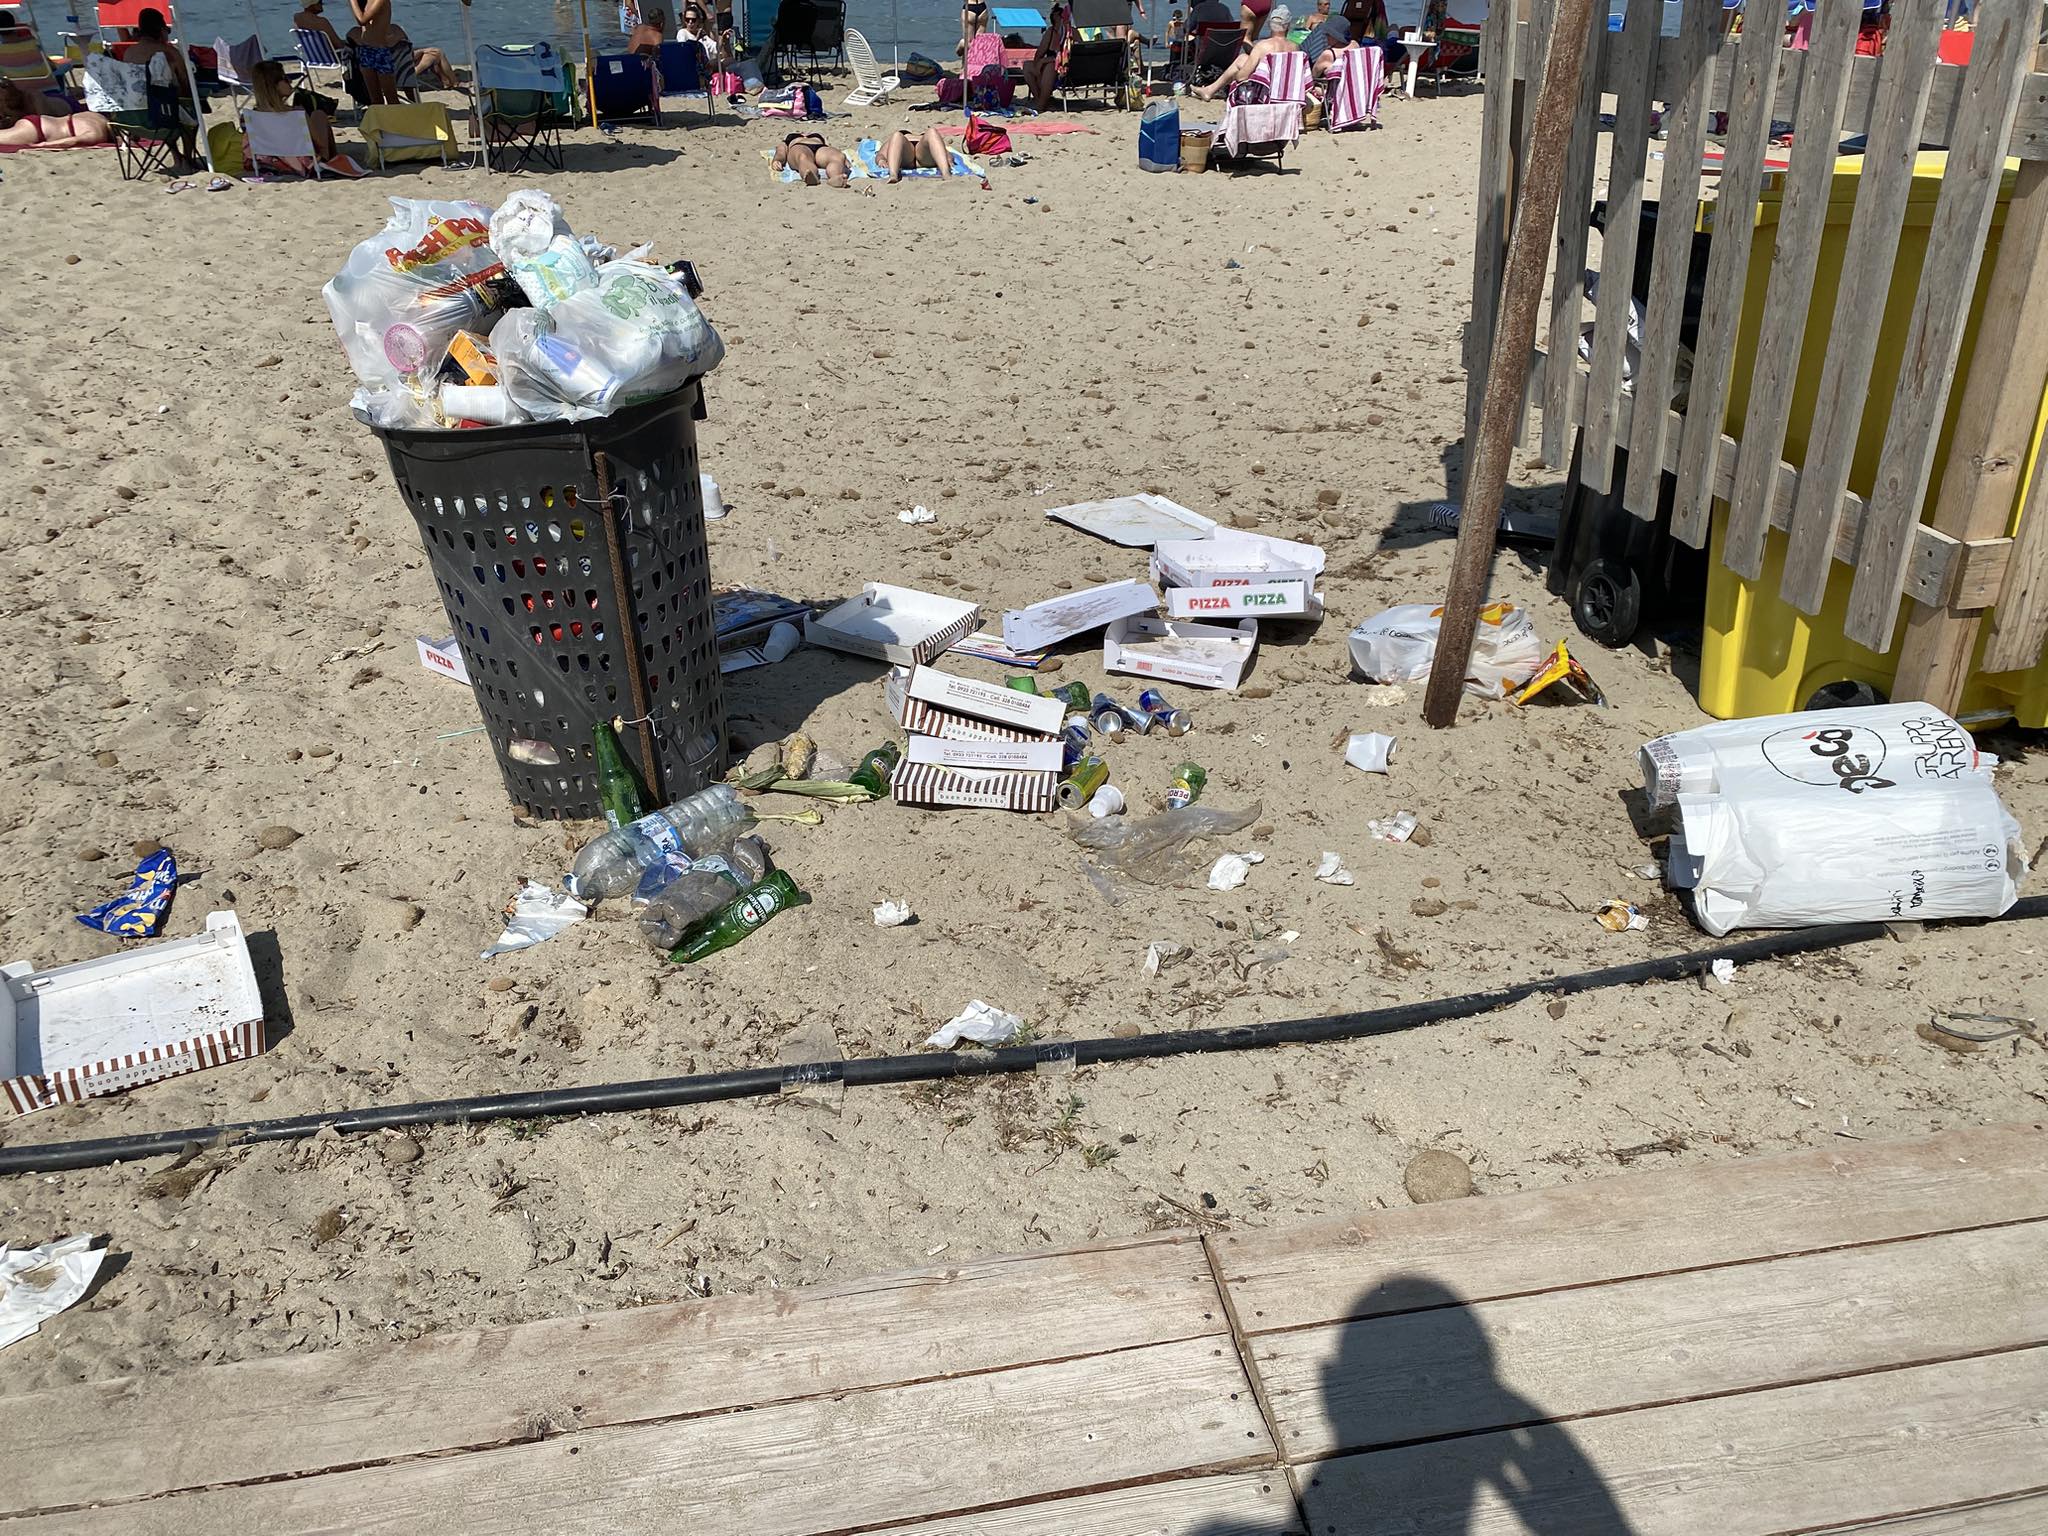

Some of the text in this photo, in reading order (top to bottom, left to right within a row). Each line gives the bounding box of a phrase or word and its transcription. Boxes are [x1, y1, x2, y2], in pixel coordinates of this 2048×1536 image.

[1189, 593, 1287, 609] PIZZA PIZZA
[426, 650, 455, 671] PIZZA
[1901, 719, 1940, 779] GRUPPO
[1927, 718, 1967, 780] ARENA
[88, 1058, 189, 1088] buon appetito
